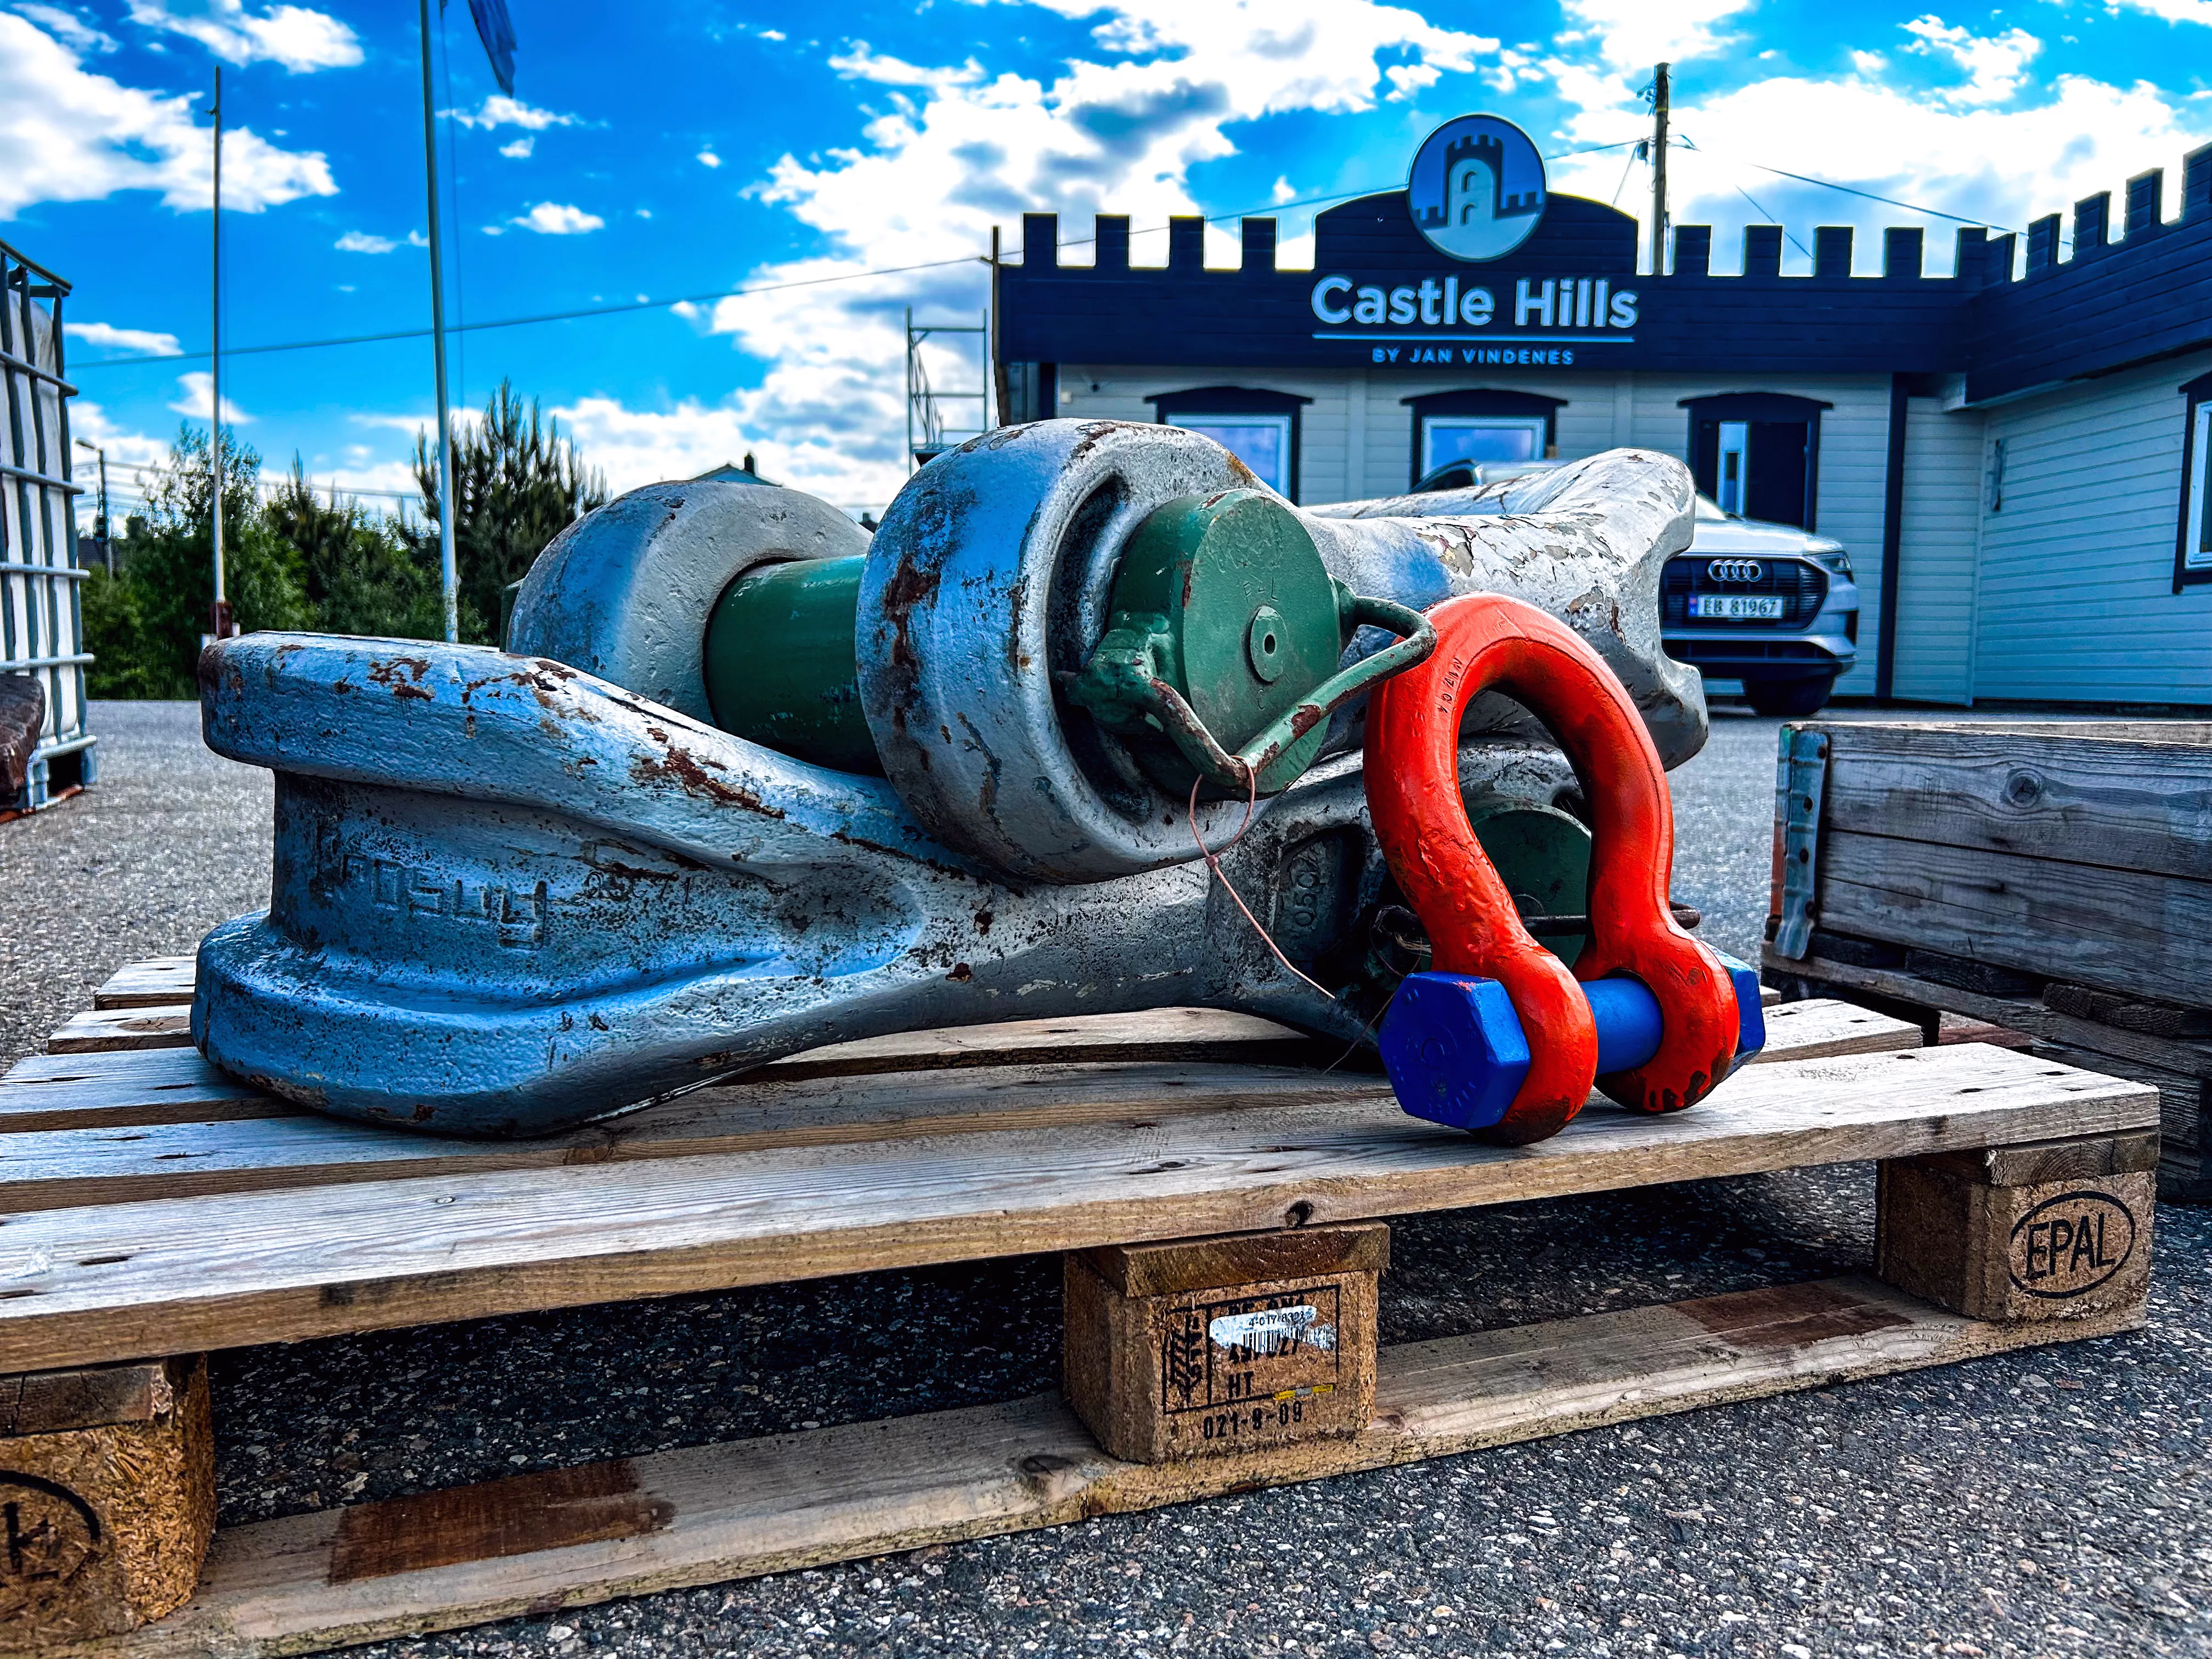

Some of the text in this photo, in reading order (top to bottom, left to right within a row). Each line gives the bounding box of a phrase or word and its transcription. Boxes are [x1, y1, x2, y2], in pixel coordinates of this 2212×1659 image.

[1311, 275, 1639, 329] Castle Hills
[1372, 348, 1575, 365] BY JAN VINDENES
[1704, 599, 1723, 615] EB
[1730, 599, 1778, 616] 81967
[2025, 1212, 2116, 1279] EPAL
[1229, 1371, 1254, 1398] HT
